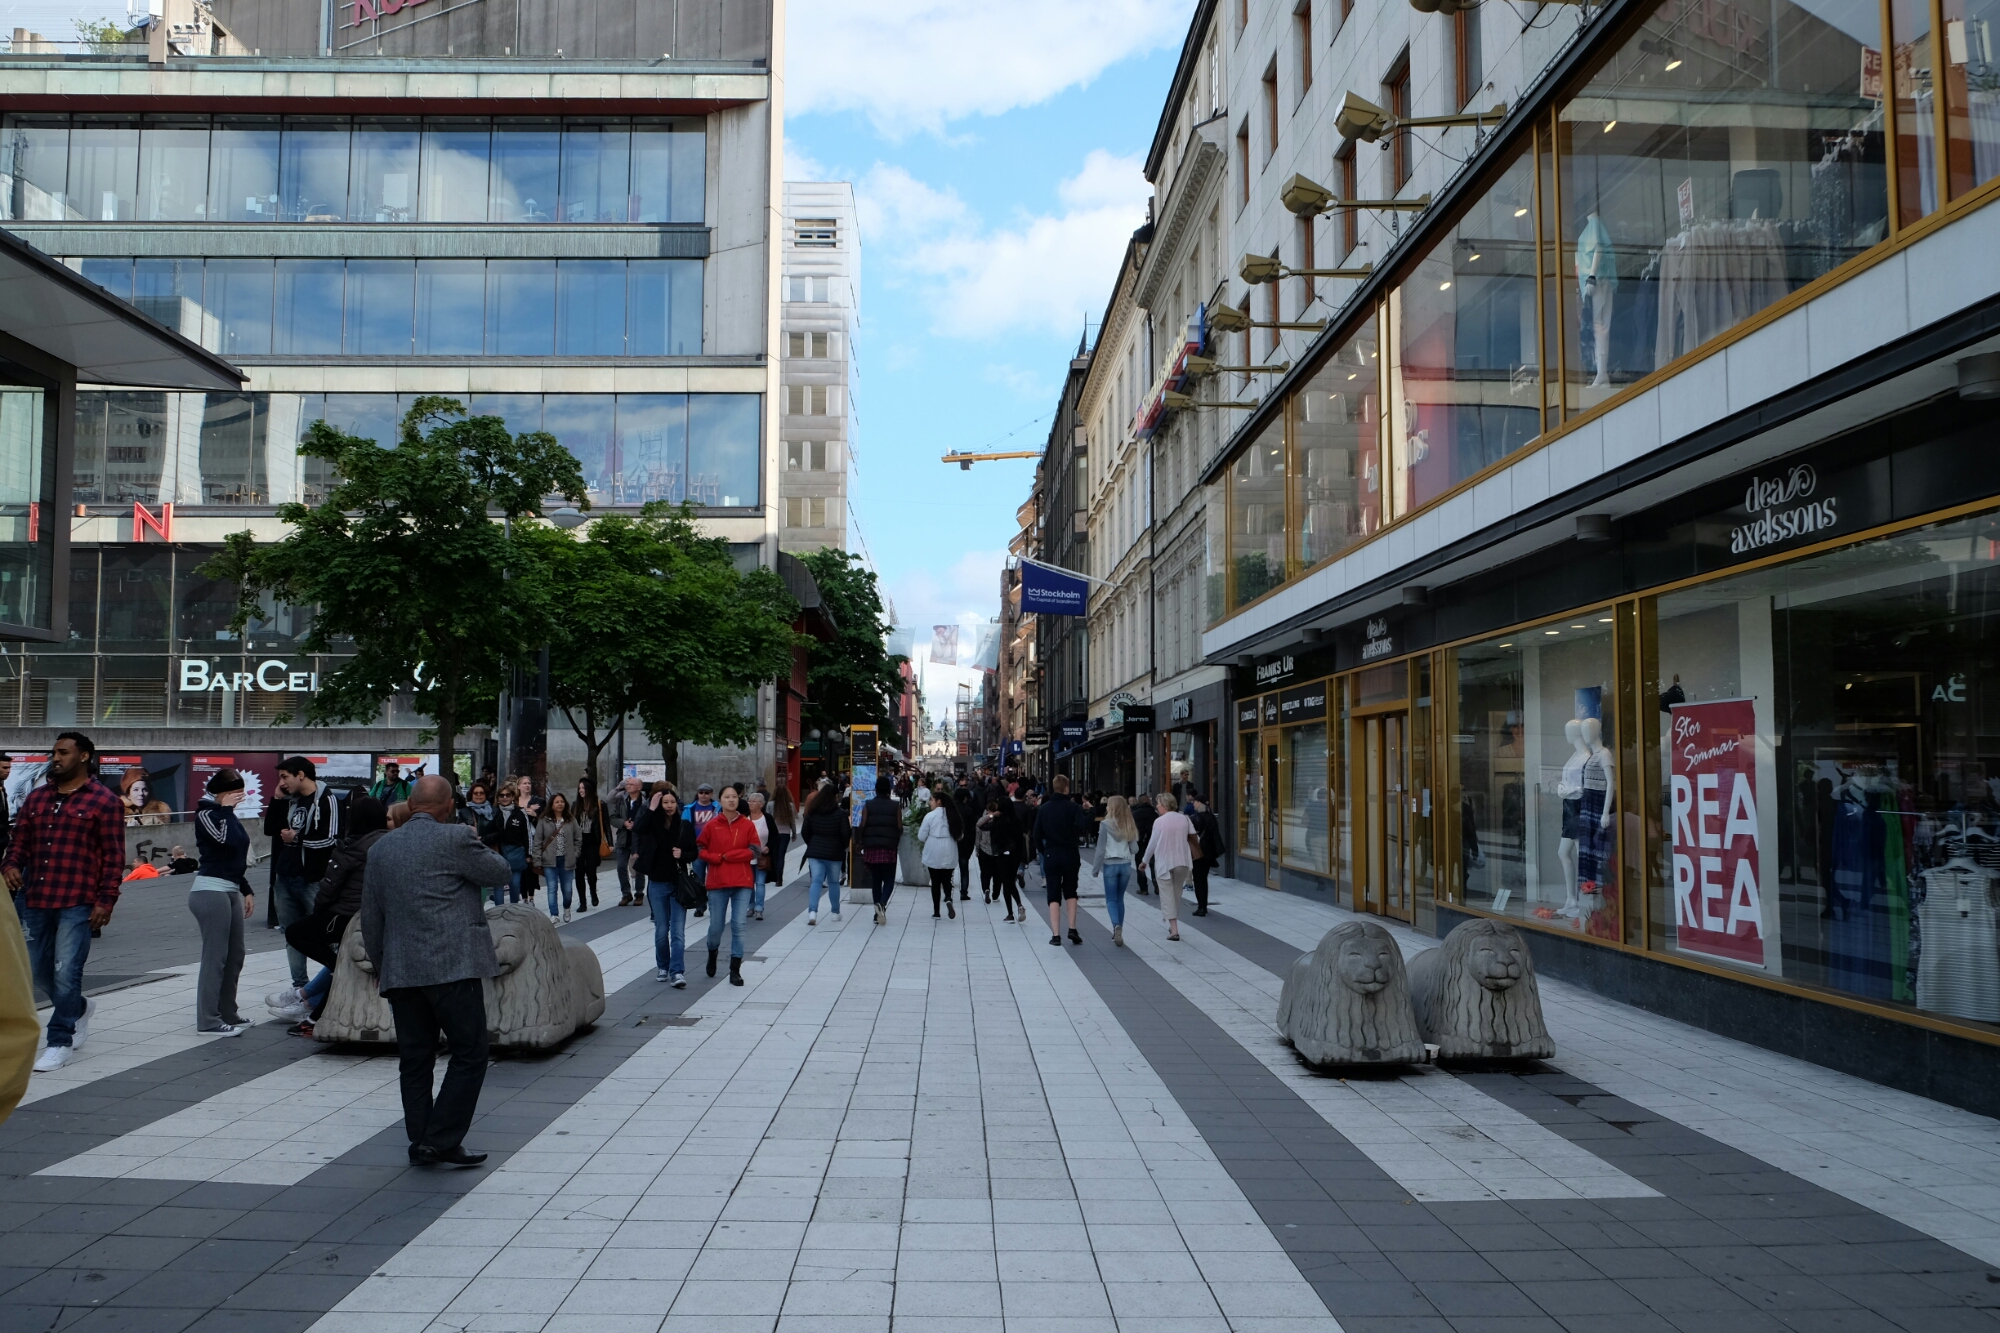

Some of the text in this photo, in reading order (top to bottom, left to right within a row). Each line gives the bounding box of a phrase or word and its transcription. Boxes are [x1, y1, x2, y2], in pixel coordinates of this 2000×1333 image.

[1745, 467, 1807, 513] dea
[1731, 497, 1837, 554] axelssons
[1040, 588, 1081, 599] Stockholm
[1256, 661, 1281, 681] FRANKS
[1675, 715, 1701, 744] Stor
[1671, 772, 1759, 851] REA
[1673, 852, 1763, 939] REA
